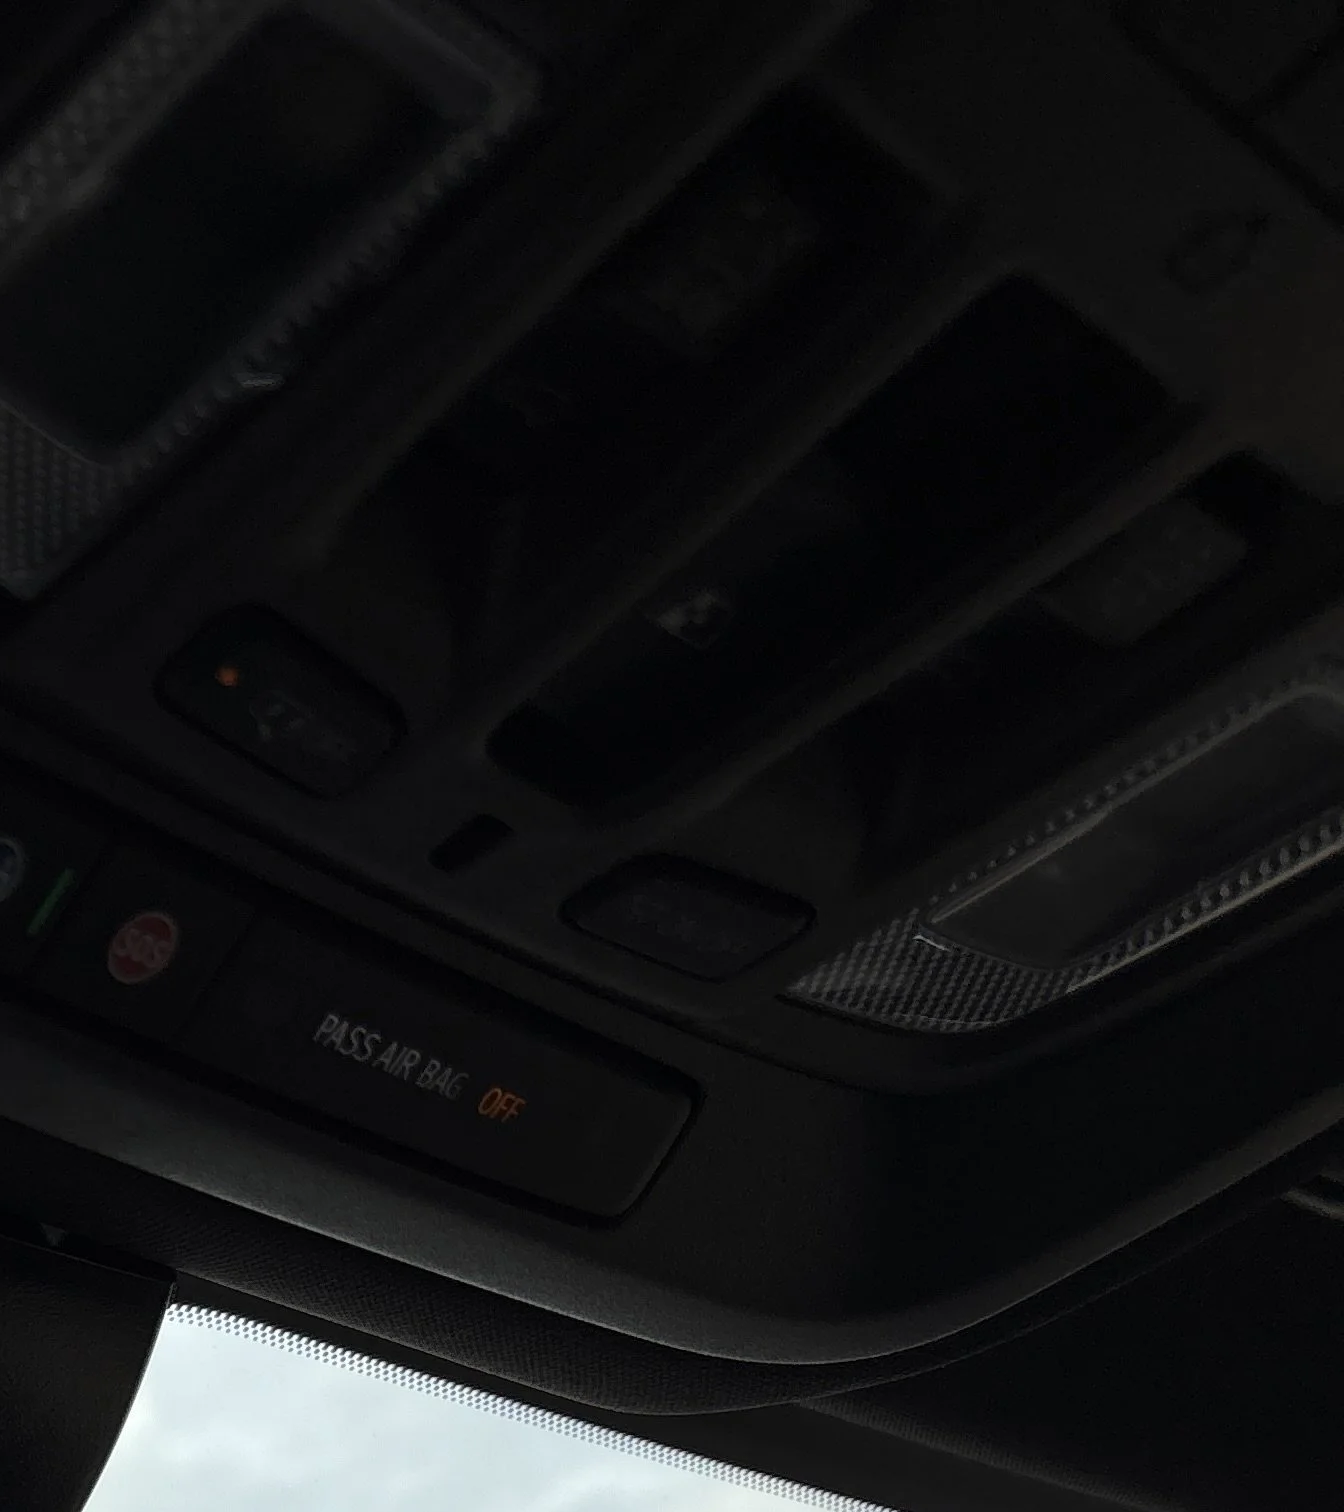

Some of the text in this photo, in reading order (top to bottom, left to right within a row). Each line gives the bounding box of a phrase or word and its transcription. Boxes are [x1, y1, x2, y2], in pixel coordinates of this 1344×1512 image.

[111, 926, 175, 969] SOS
[313, 1012, 527, 1124] PASS AIR BAG OFF
